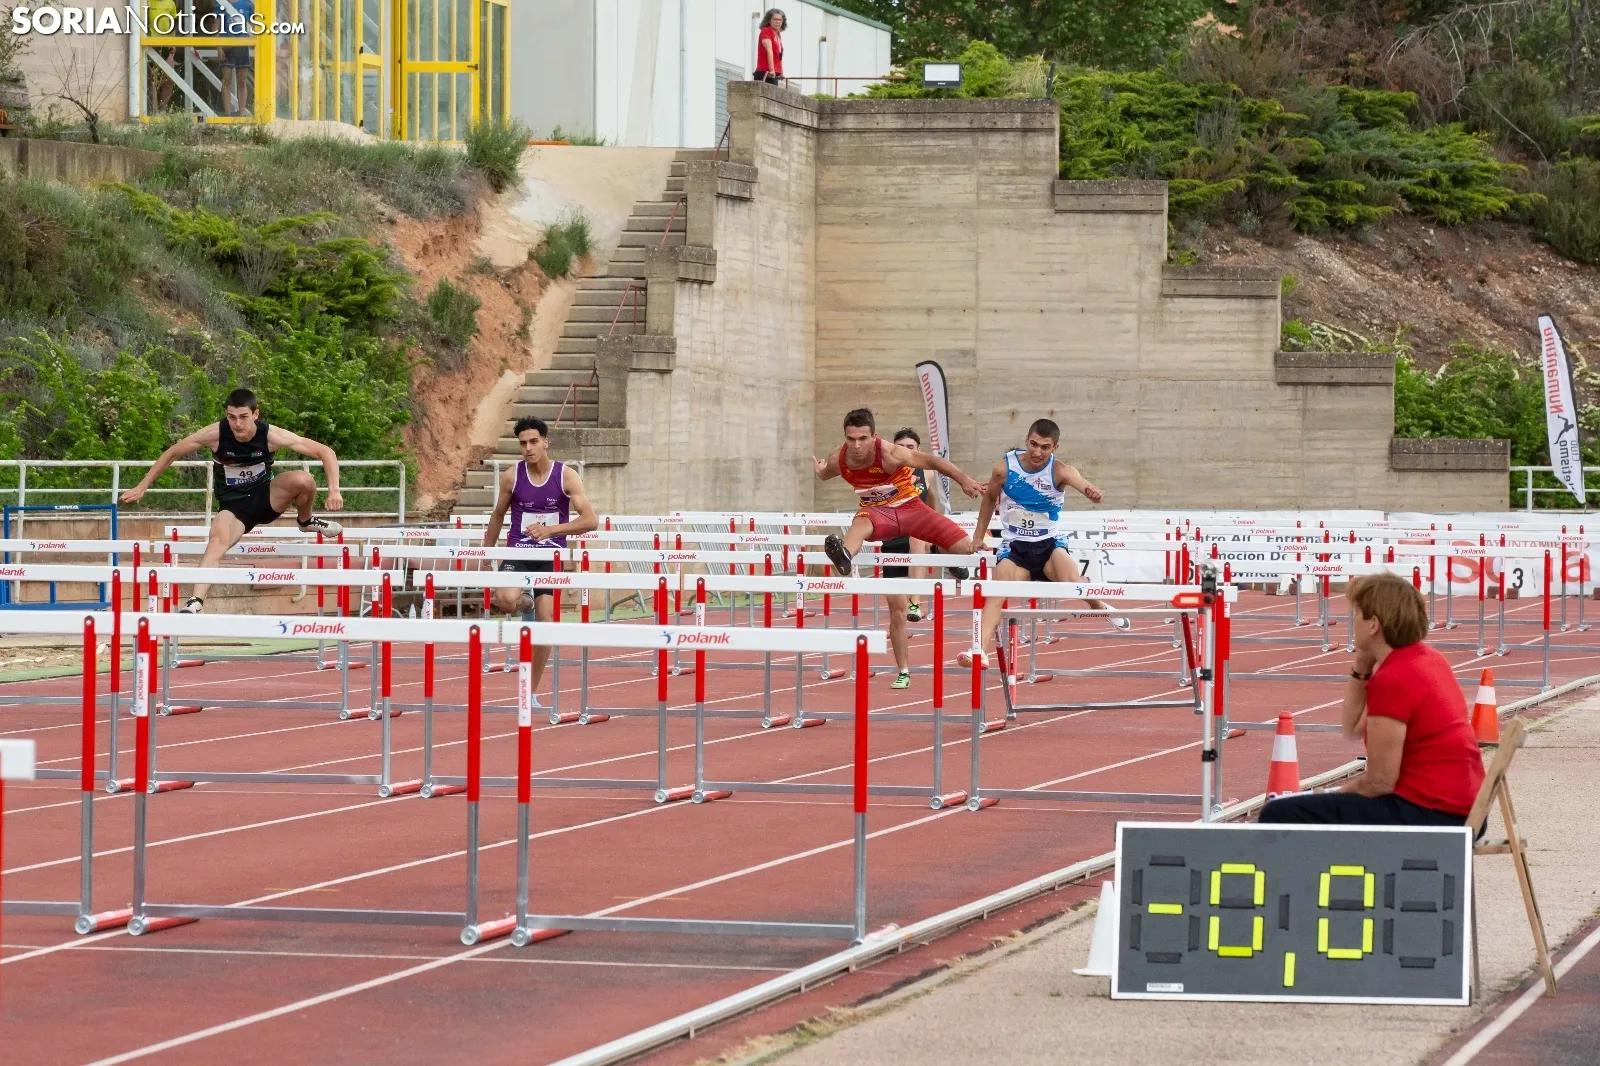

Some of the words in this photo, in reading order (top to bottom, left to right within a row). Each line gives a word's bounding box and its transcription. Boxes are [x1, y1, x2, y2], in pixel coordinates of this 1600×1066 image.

[239, 470, 253, 478] 49
[1021, 518, 1035, 529] 39
[1107, 524, 1129, 532] polanik
[405, 530, 431, 538] polanik
[574, 532, 600, 540] polanik
[38, 541, 68, 550] polanik
[247, 545, 276, 553] polanik
[1101, 541, 1126, 549] polanik
[1283, 544, 1308, 552] polanik
[457, 549, 487, 557] polanik
[667, 552, 698, 560] polanik
[1460, 548, 1487, 556] polanik
[882, 556, 912, 564] polanik
[1079, 559, 1090, 577] 7
[1312, 564, 1343, 573] polanik
[257, 572, 296, 582] polanik
[533, 576, 572, 586] polanik
[1512, 567, 1524, 590] 3
[806, 581, 846, 591] polanik
[1086, 587, 1126, 597] polanik
[292, 622, 346, 636] polanik
[676, 632, 731, 646] polanik
